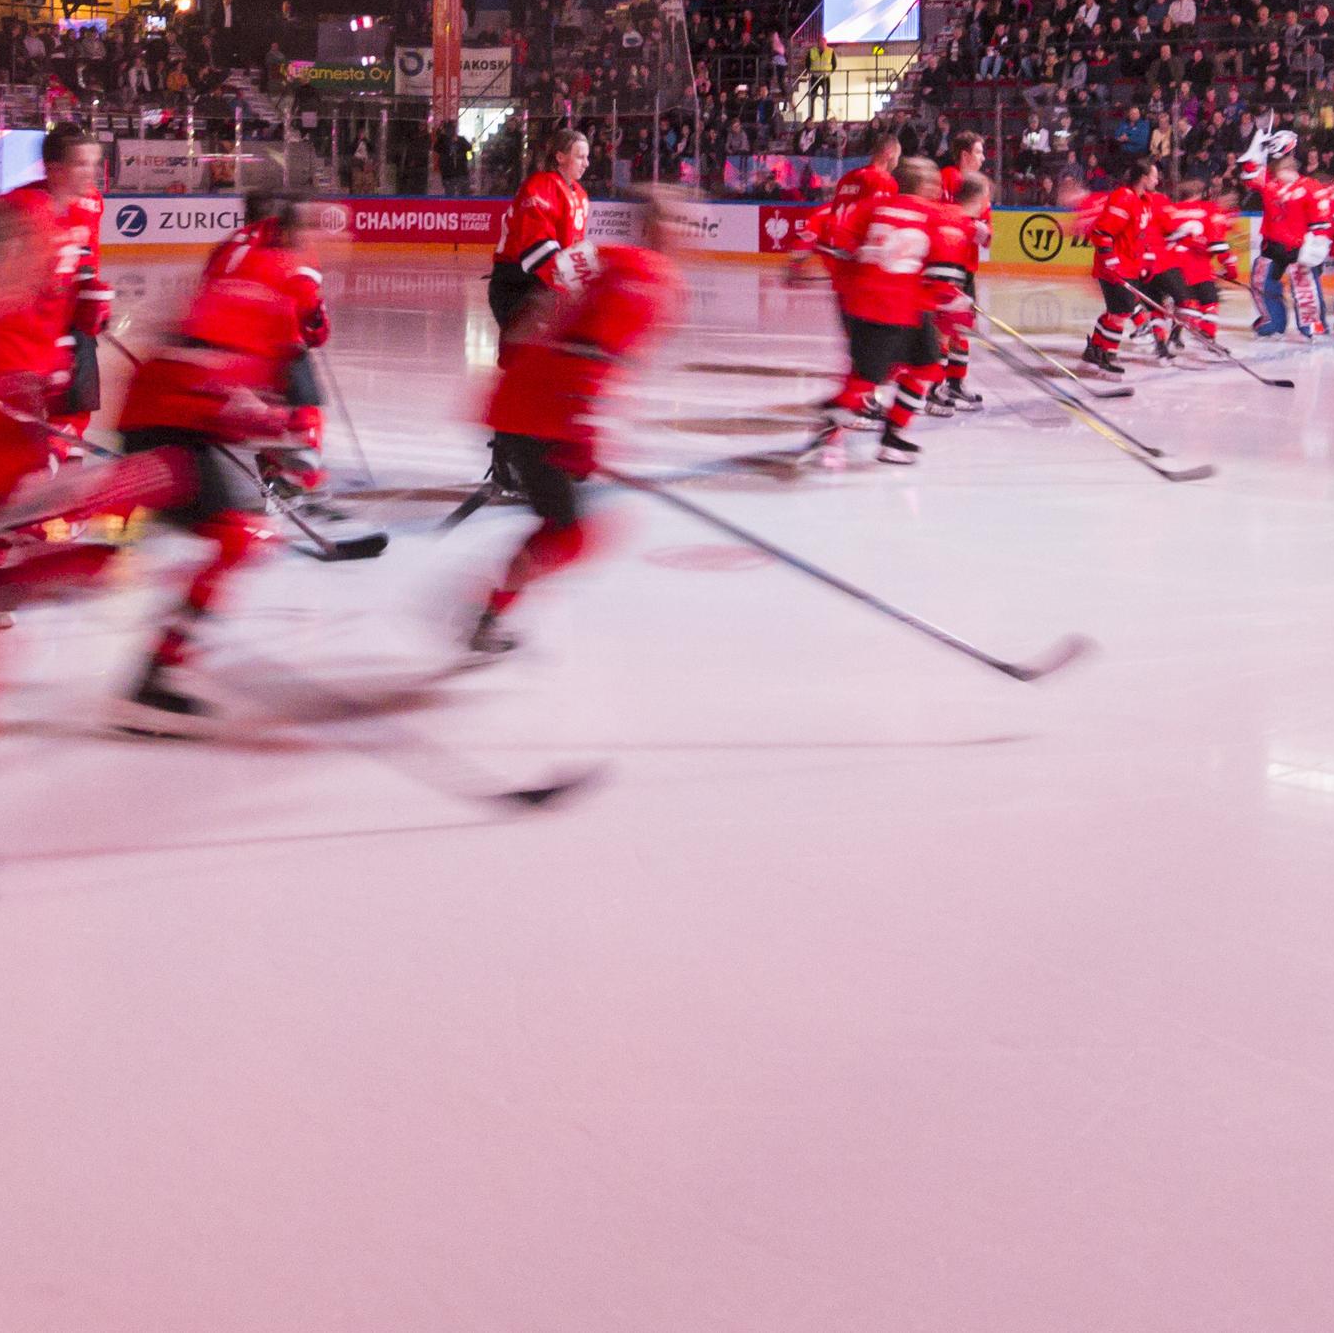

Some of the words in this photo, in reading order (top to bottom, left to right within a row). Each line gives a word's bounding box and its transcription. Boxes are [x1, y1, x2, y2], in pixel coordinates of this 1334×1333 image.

[369, 65, 392, 84] Oy
[354, 212, 459, 231] CHAMPIONS
[460, 212, 492, 221] HOCKEY
[460, 221, 490, 231] LEAGUE
[596, 219, 631, 227] LEADING
[588, 227, 602, 236] EYE
